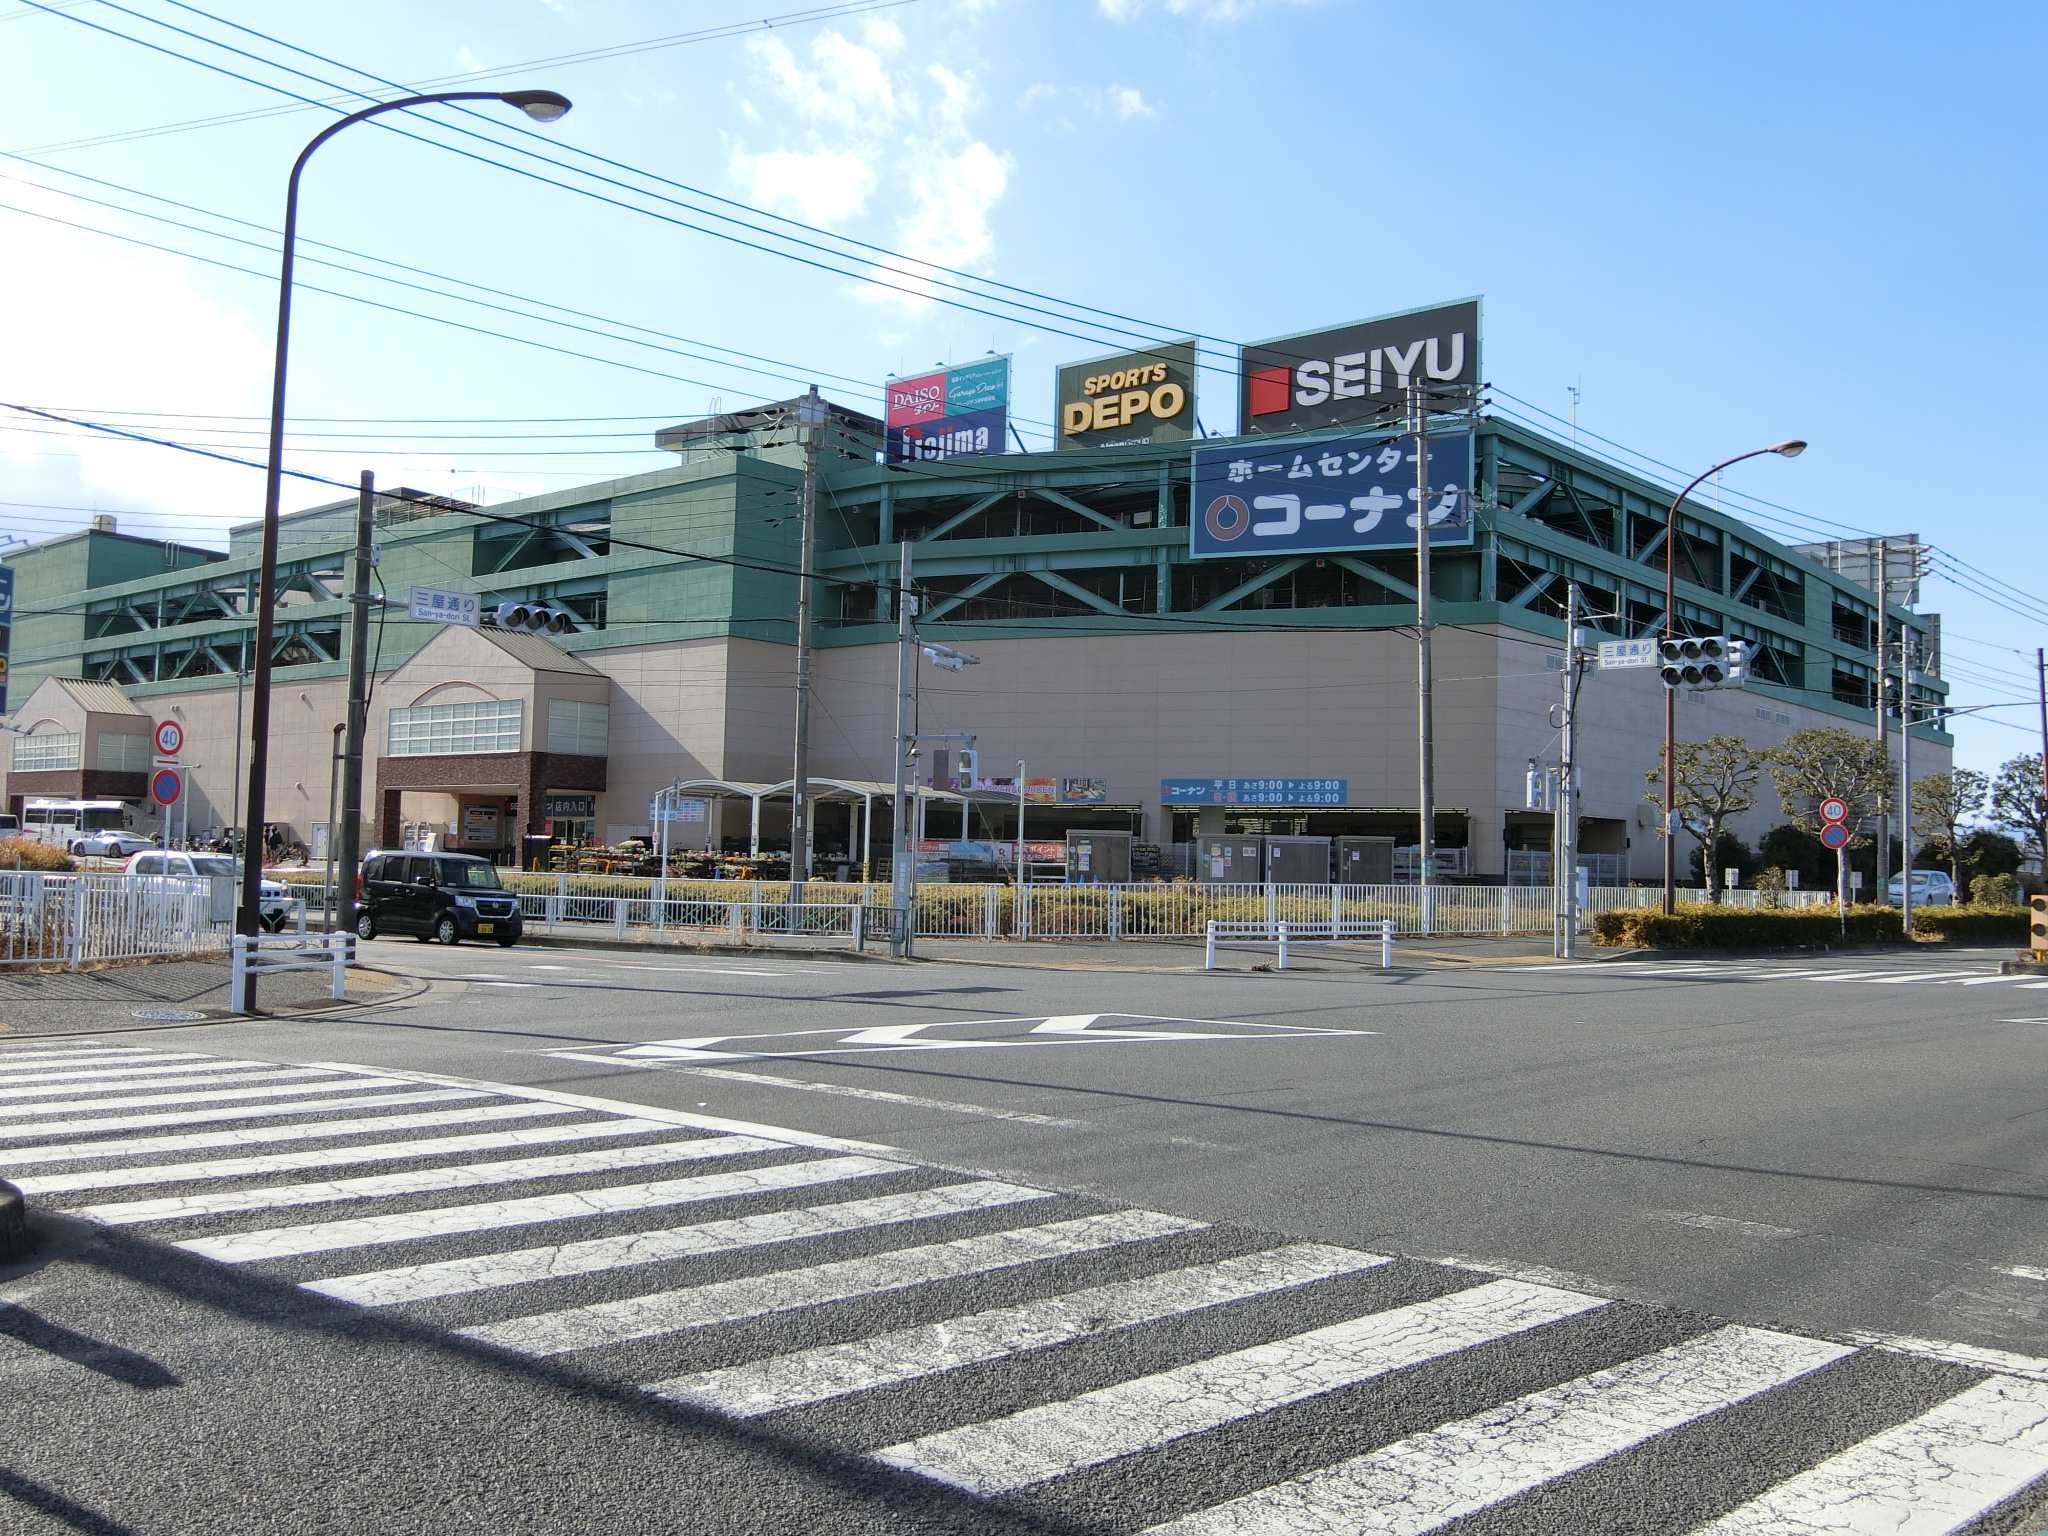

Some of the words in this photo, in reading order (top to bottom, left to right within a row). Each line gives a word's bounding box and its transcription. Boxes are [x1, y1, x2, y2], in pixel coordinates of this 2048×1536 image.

[1295, 332, 1465, 407] SEIYU
[1083, 362, 1168, 396] SPORTS
[893, 385, 941, 408] DAISO
[913, 402, 940, 416] ダイソー
[1063, 383, 1186, 436] DEPO
[902, 426, 989, 463] Nojima
[1228, 447, 1433, 483] ホームセンター
[1253, 483, 1458, 537] コーナン
[416, 592, 475, 612] 三屋通り
[418, 608, 460, 621] San-ya-dori
[462, 613, 472, 623] St.
[1604, 643, 1652, 657] 三屋通り
[1604, 657, 1638, 667] San-ya-dori
[1640, 656, 1649, 664] St.
[161, 730, 178, 746] 40
[1171, 786, 1206, 795] コーナン
[1242, 780, 1283, 790] あさ9:00
[1298, 780, 1340, 790] よる9:00
[1242, 793, 1283, 802] あさ9:00
[1298, 793, 1339, 802] よる9:00
[555, 801, 585, 812] 店内入口
[1827, 806, 1841, 816] 40
